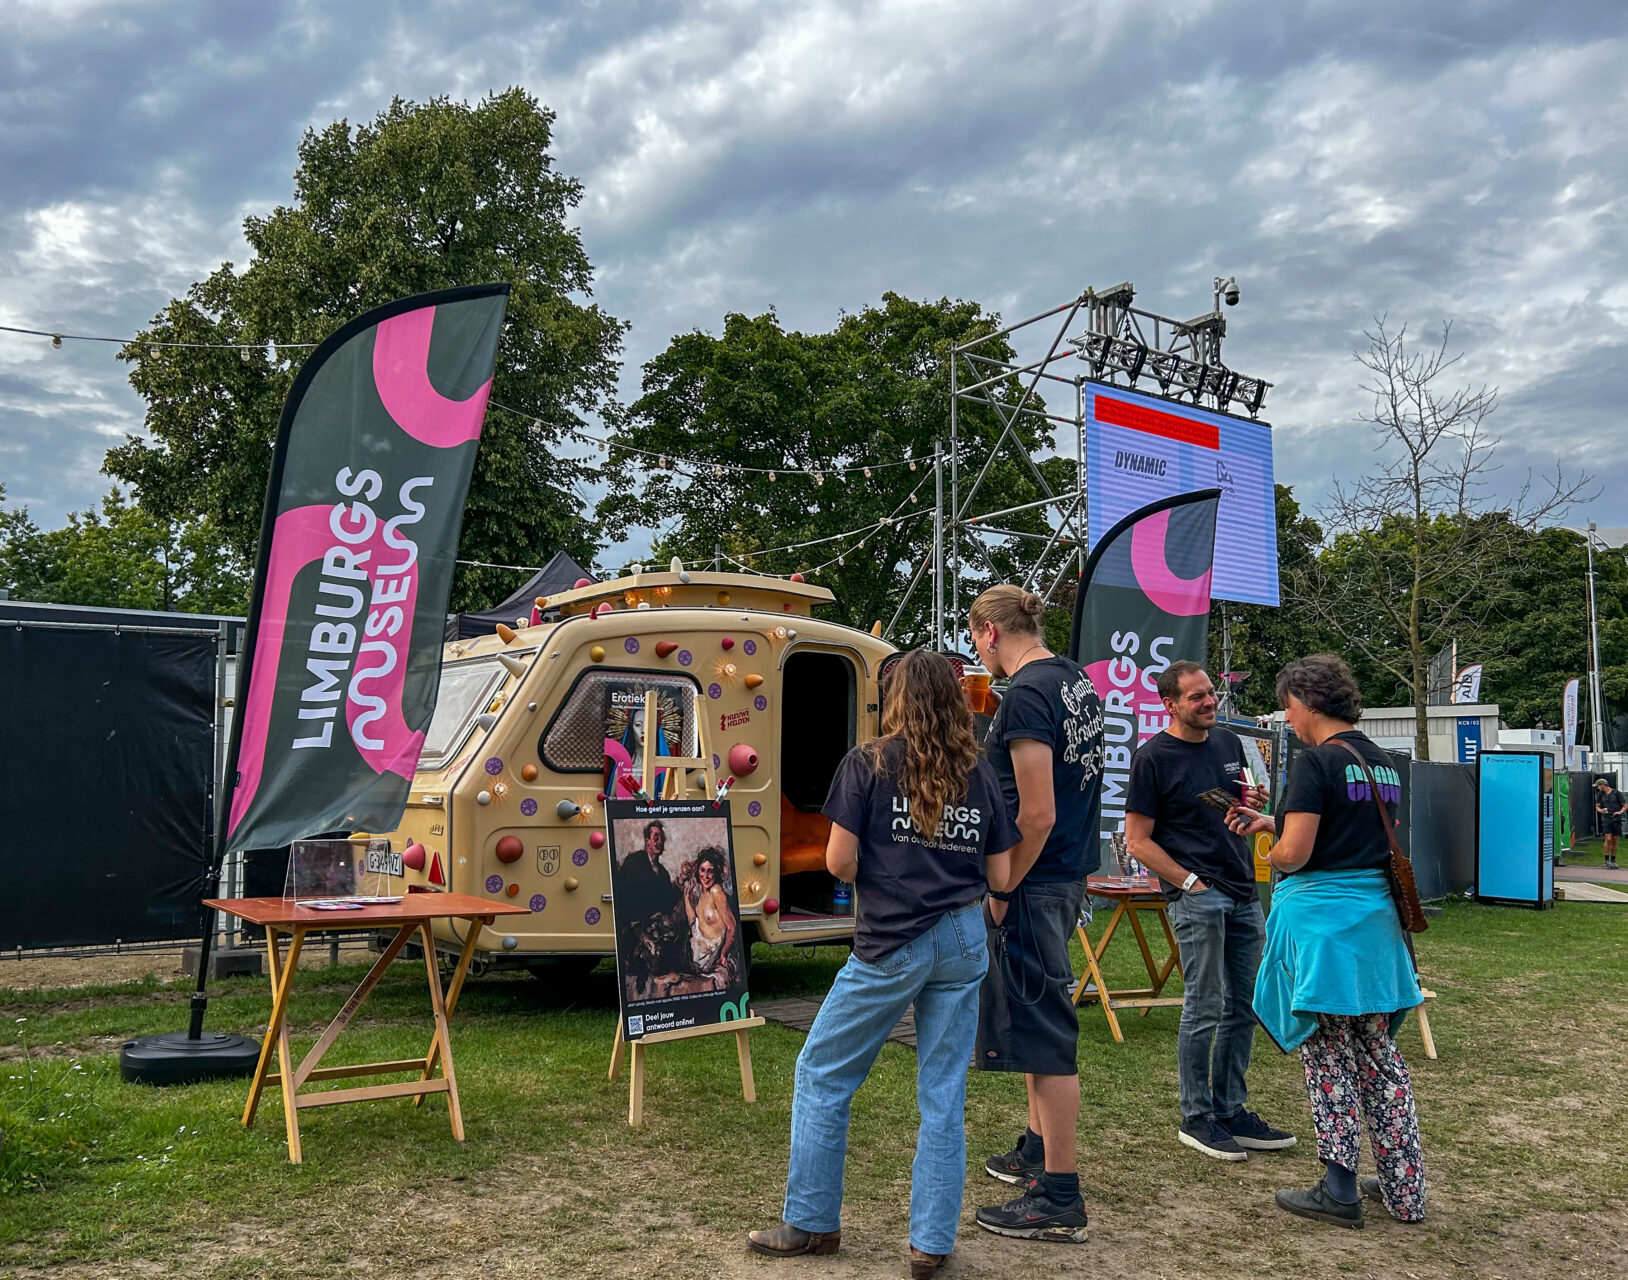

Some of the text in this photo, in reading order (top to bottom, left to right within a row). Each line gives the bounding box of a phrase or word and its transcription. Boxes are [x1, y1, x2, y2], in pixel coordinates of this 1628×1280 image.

[1114, 450, 1167, 477] DYNAMIC
[292, 466, 383, 749] LIMBURGS
[611, 692, 646, 704] Erotiek
[635, 805, 647, 813] Hoe
[648, 805, 661, 814] geef
[662, 805, 668, 814] je
[669, 806, 691, 814] grenzen
[892, 796, 981, 825] LIRGS
[892, 815, 980, 842] MEUM
[891, 833, 909, 843] Van
[645, 1012, 675, 1021] Deel jouw
[646, 1017, 695, 1031] antwoord online!
